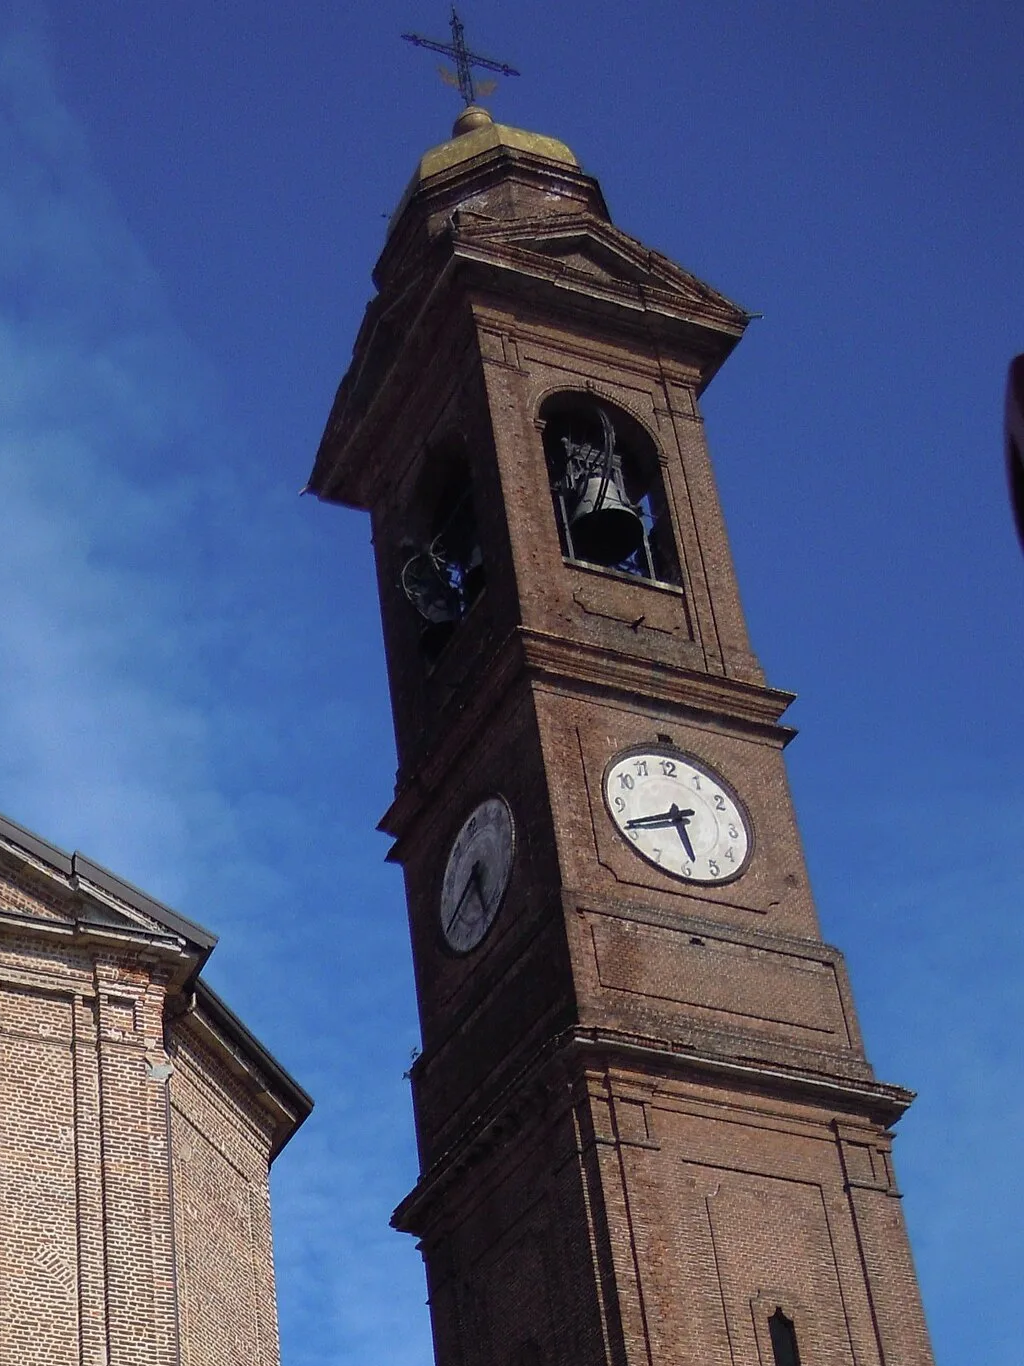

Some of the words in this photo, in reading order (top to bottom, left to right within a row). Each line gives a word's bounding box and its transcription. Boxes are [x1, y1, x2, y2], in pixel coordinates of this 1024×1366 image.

[633, 760, 649, 776] 11
[659, 760, 678, 778] 12
[617, 772, 634, 790] 10
[691, 775, 702, 790] 1
[614, 796, 626, 813] 9
[713, 794, 727, 812] 2
[728, 823, 739, 839] 3
[652, 848, 663, 863] 7
[724, 846, 735, 863] 4
[680, 860, 692, 877] 6
[708, 859, 721, 877] 5
